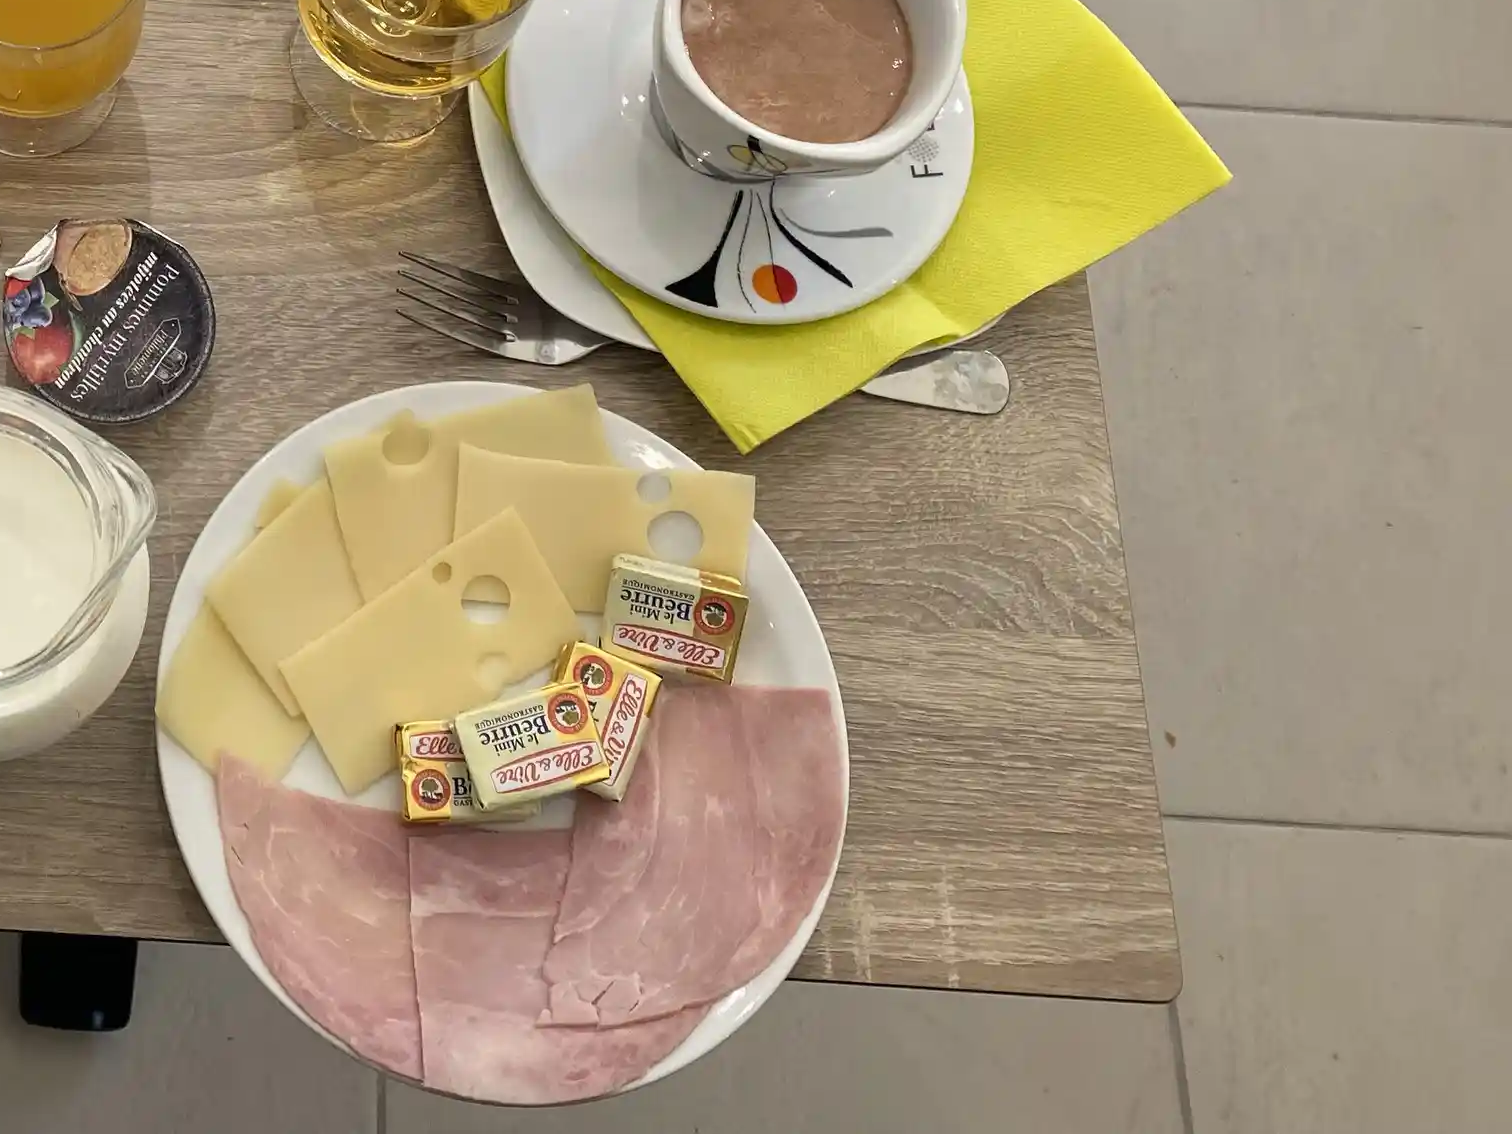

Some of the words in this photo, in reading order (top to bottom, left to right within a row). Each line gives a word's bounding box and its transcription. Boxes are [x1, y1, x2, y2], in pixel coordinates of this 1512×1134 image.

[113, 251, 159, 309] mijotées
[120, 262, 180, 336] Pommes
[99, 306, 118, 327] au
[52, 323, 107, 393] chaudron
[68, 329, 131, 407] myrtilles
[622, 578, 694, 600] GASTRONOMIQUE
[618, 588, 692, 620] Beurre
[628, 603, 659, 620] Mini
[662, 611, 674, 624] le
[473, 704, 544, 729] GASTRONOMIQUE
[477, 714, 550, 749] Beurre
[526, 733, 538, 746] le
[416, 736, 457, 754] Elle
[493, 736, 525, 755] Mini
